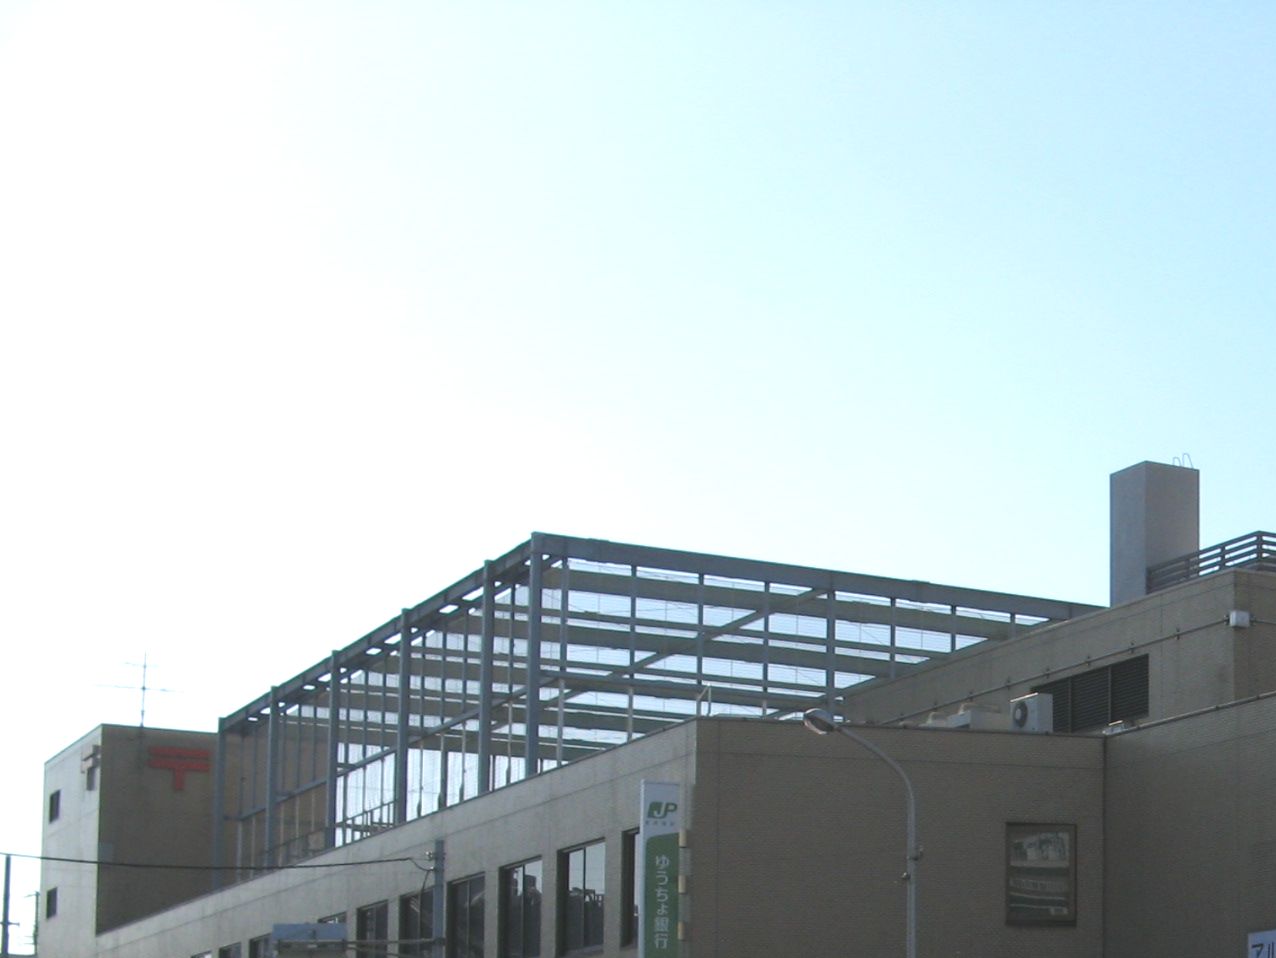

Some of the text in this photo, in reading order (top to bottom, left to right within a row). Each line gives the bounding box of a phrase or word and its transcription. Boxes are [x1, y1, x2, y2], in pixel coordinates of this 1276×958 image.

[647, 801, 678, 819] JP
[654, 855, 670, 949] ゆうちょ銀行
